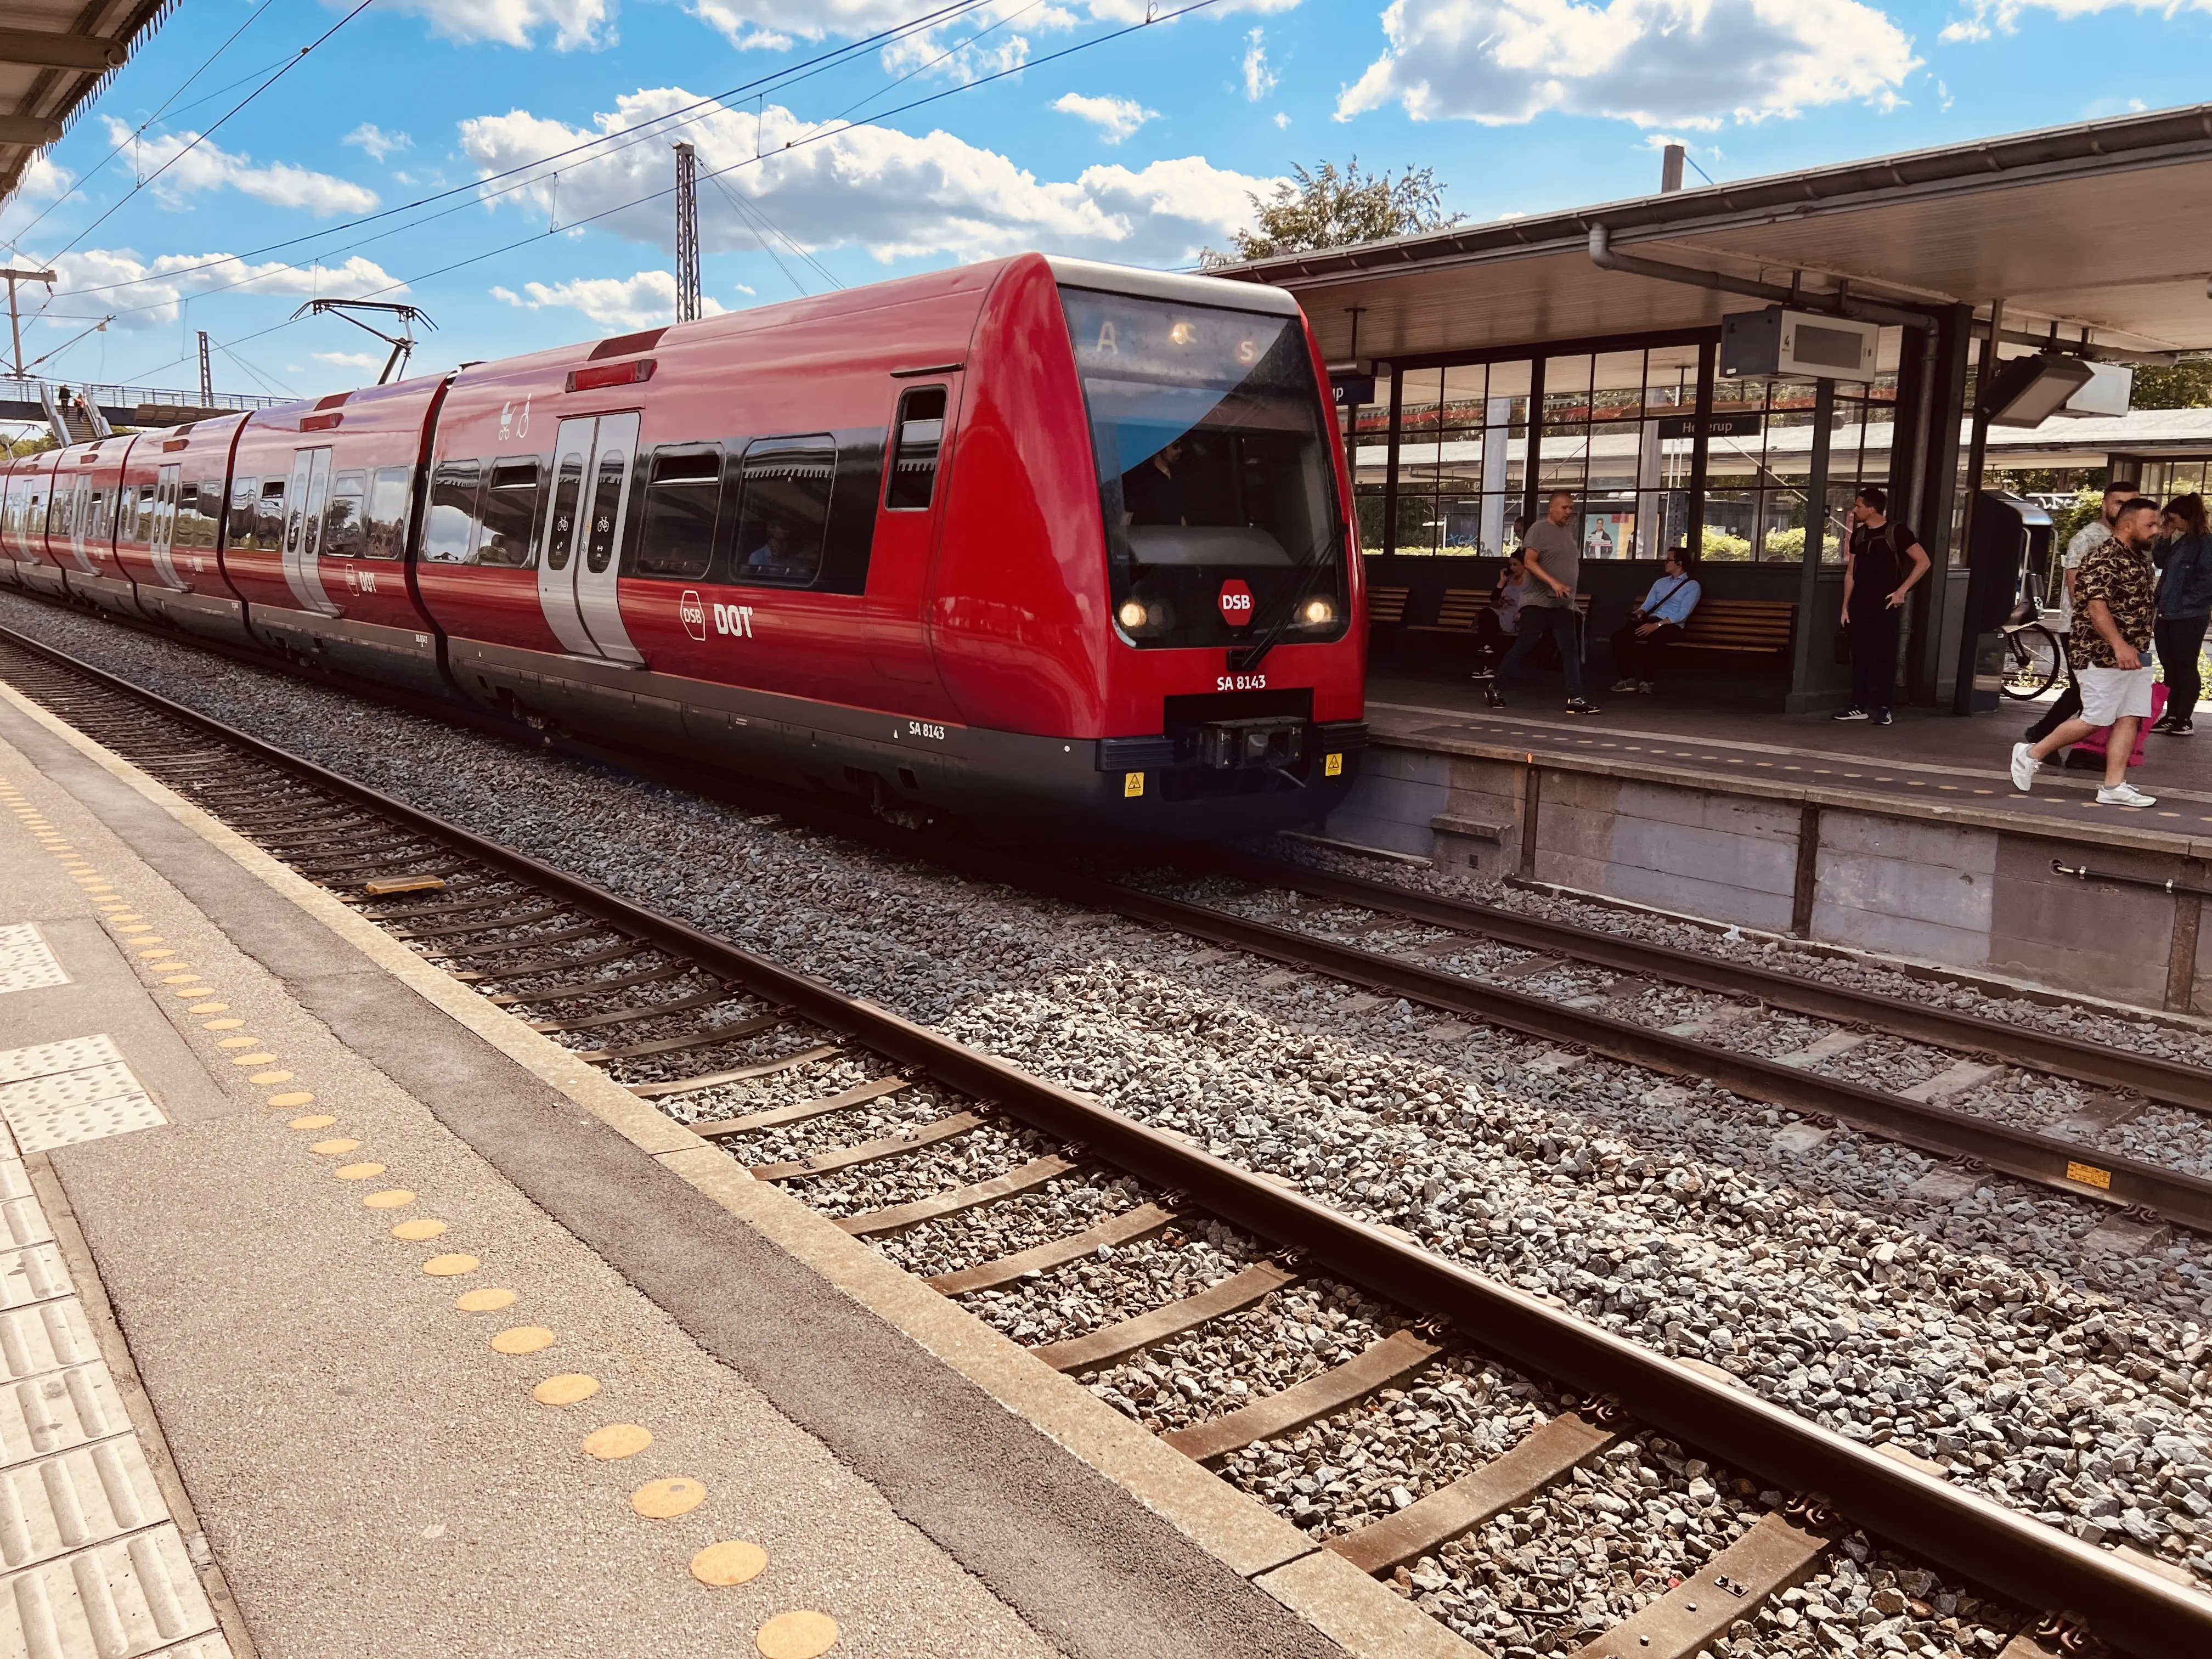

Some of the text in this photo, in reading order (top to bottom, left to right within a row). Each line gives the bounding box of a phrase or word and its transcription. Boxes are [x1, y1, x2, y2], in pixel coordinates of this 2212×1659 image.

[1097, 321, 1119, 354] A
[1222, 594, 1250, 610] DSB
[683, 607, 702, 624] DSB
[714, 603, 753, 638] DOT
[1217, 675, 1266, 691] SA 8143
[909, 721, 945, 740] SA 8143
